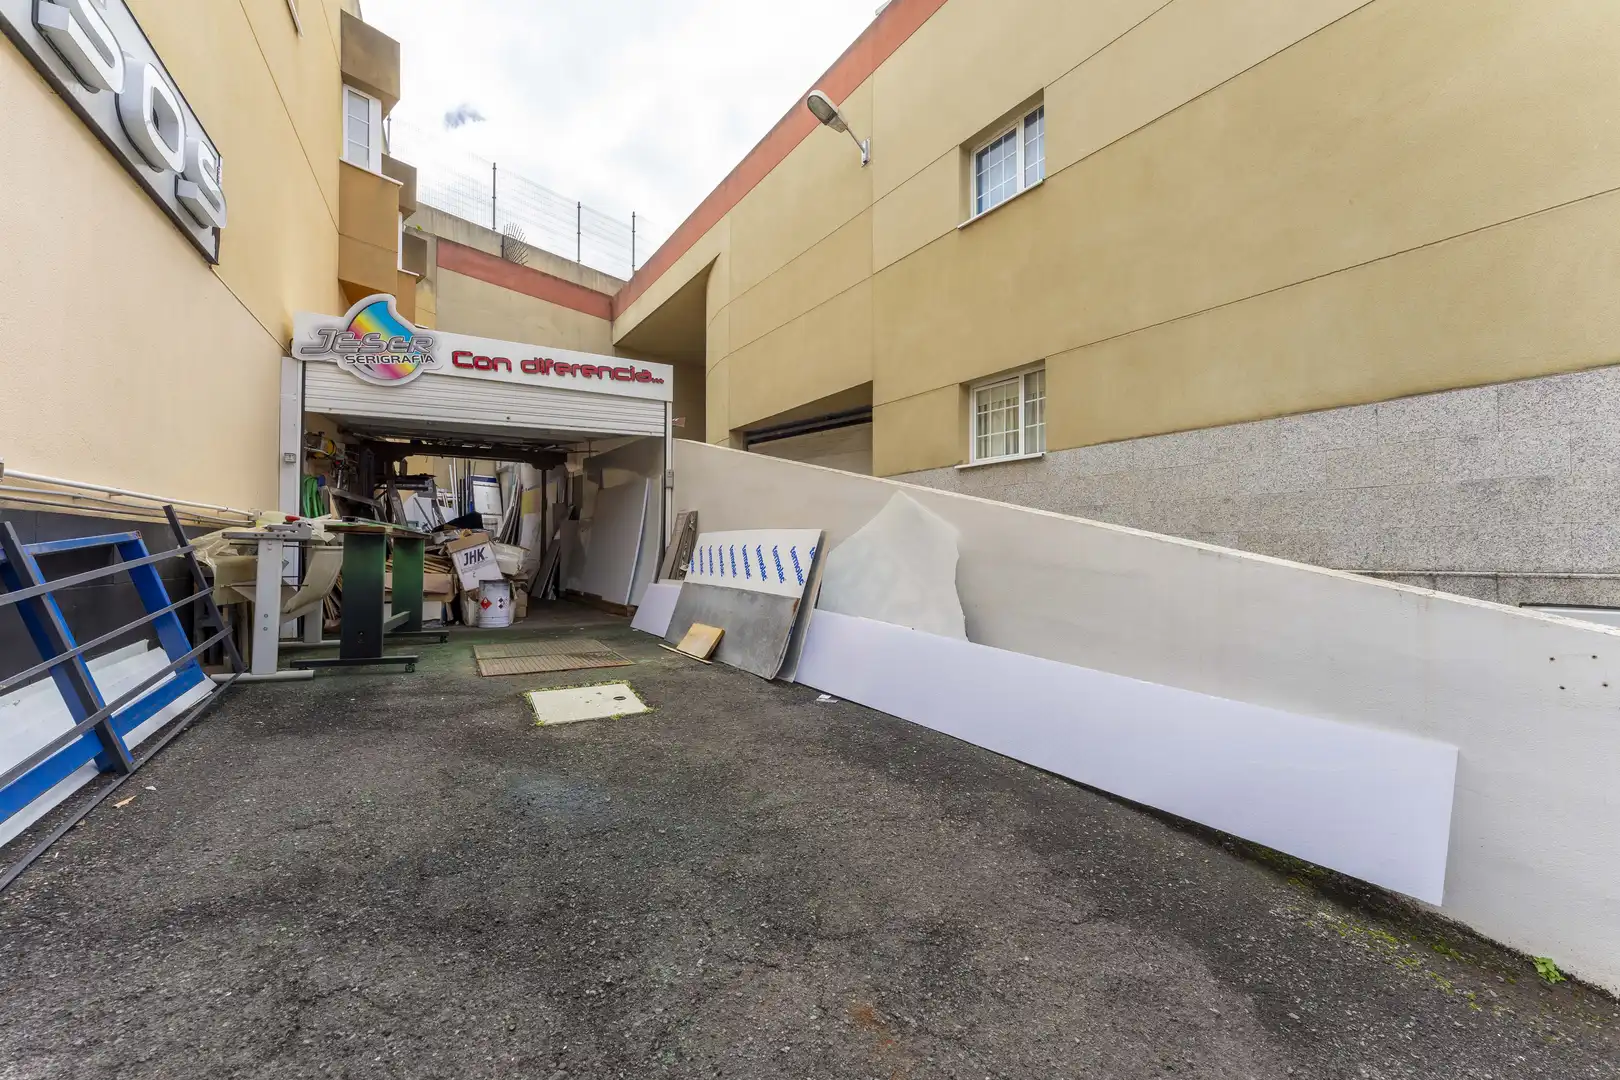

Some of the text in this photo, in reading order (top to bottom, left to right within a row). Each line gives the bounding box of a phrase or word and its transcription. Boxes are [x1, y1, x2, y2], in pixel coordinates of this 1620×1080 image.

[451, 350, 664, 384] Con diferencia...
[463, 546, 486, 567] JHK
